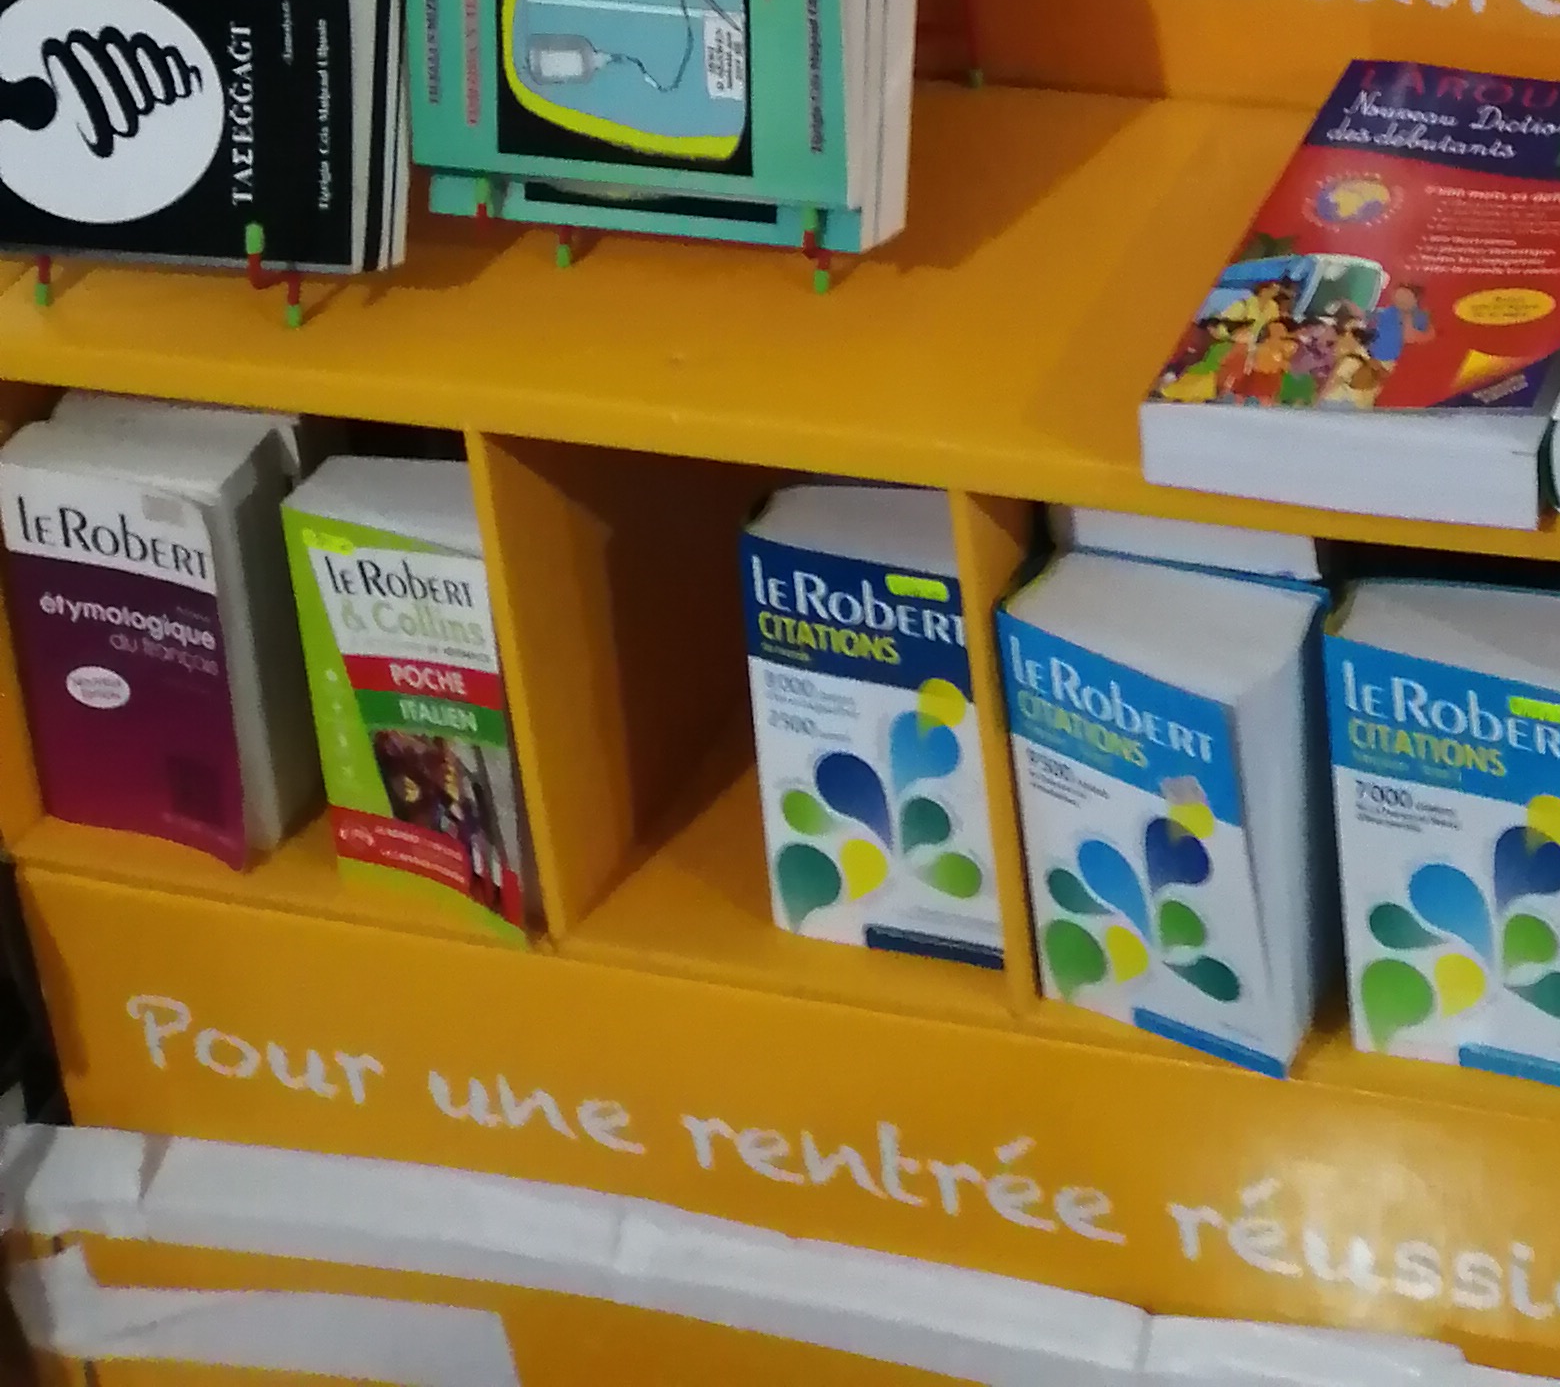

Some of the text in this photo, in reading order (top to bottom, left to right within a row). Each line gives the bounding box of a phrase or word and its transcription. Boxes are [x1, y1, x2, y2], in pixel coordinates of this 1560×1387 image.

[39, 591, 218, 652] étymologique
[757, 610, 901, 666] CITATIONS
[389, 661, 468, 697] POCHE
[1347, 716, 1509, 779] CITATIONS
[126, 993, 385, 1105] Pour
[429, 1068, 647, 1155] une
[680, 1111, 1128, 1246] rentrée
